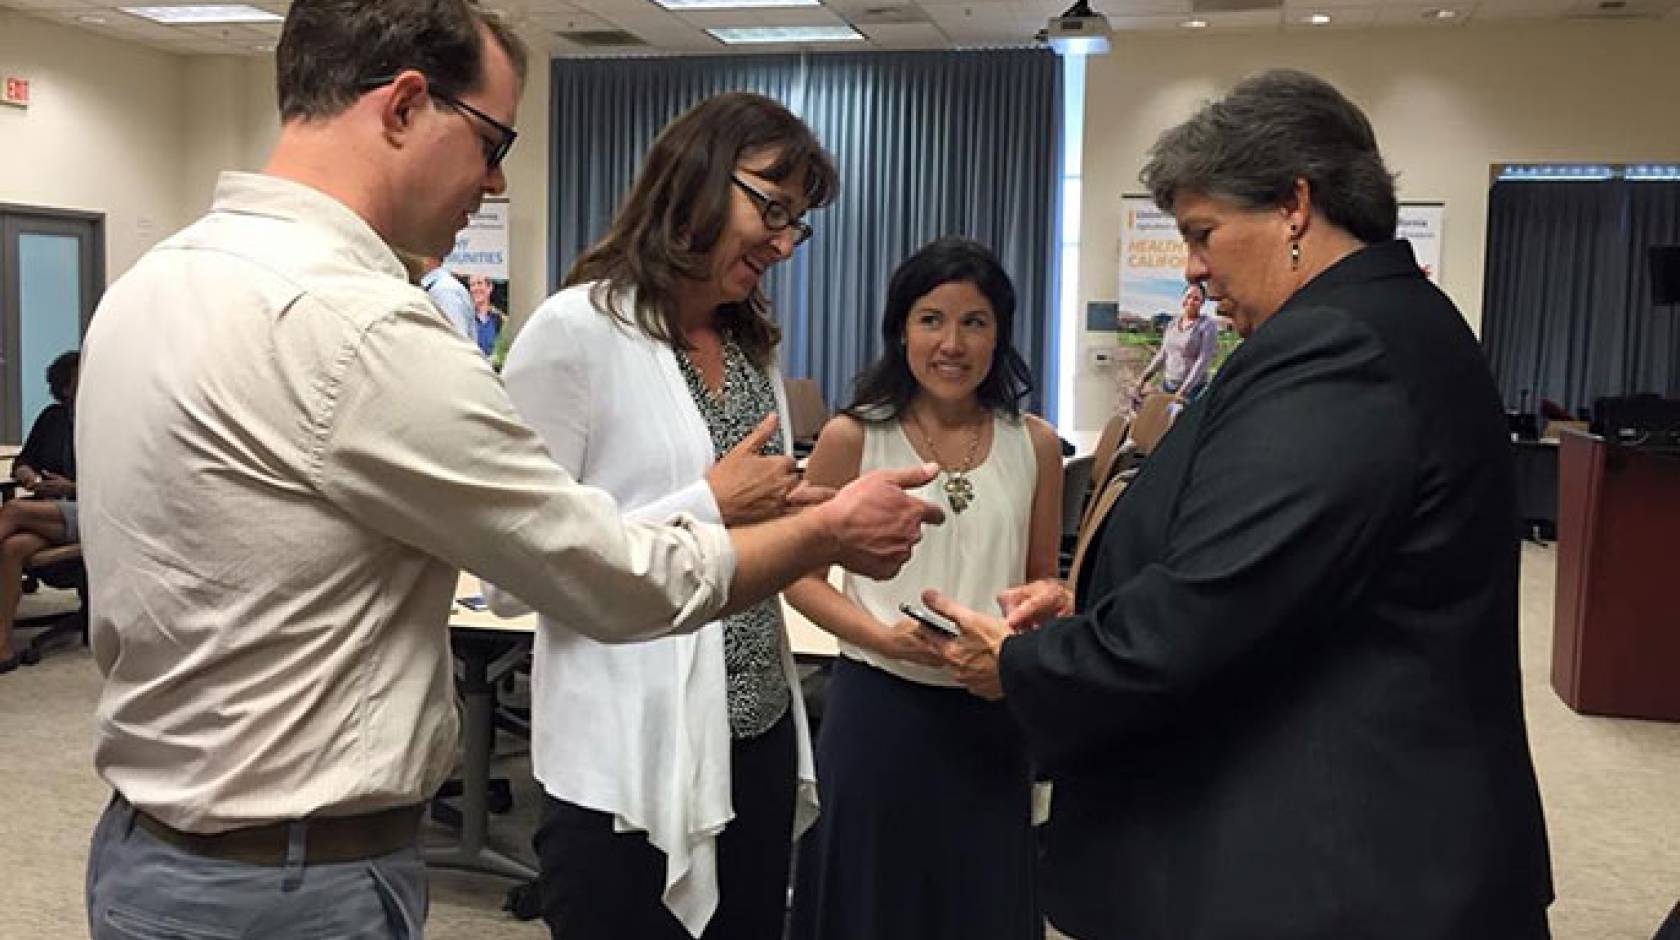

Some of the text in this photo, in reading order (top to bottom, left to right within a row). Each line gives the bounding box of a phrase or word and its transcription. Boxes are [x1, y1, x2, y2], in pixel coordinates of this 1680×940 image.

[9, 80, 28, 98] EXIT
[1129, 239, 1187, 253] HEALTH
[1128, 254, 1186, 267] CALIFO
